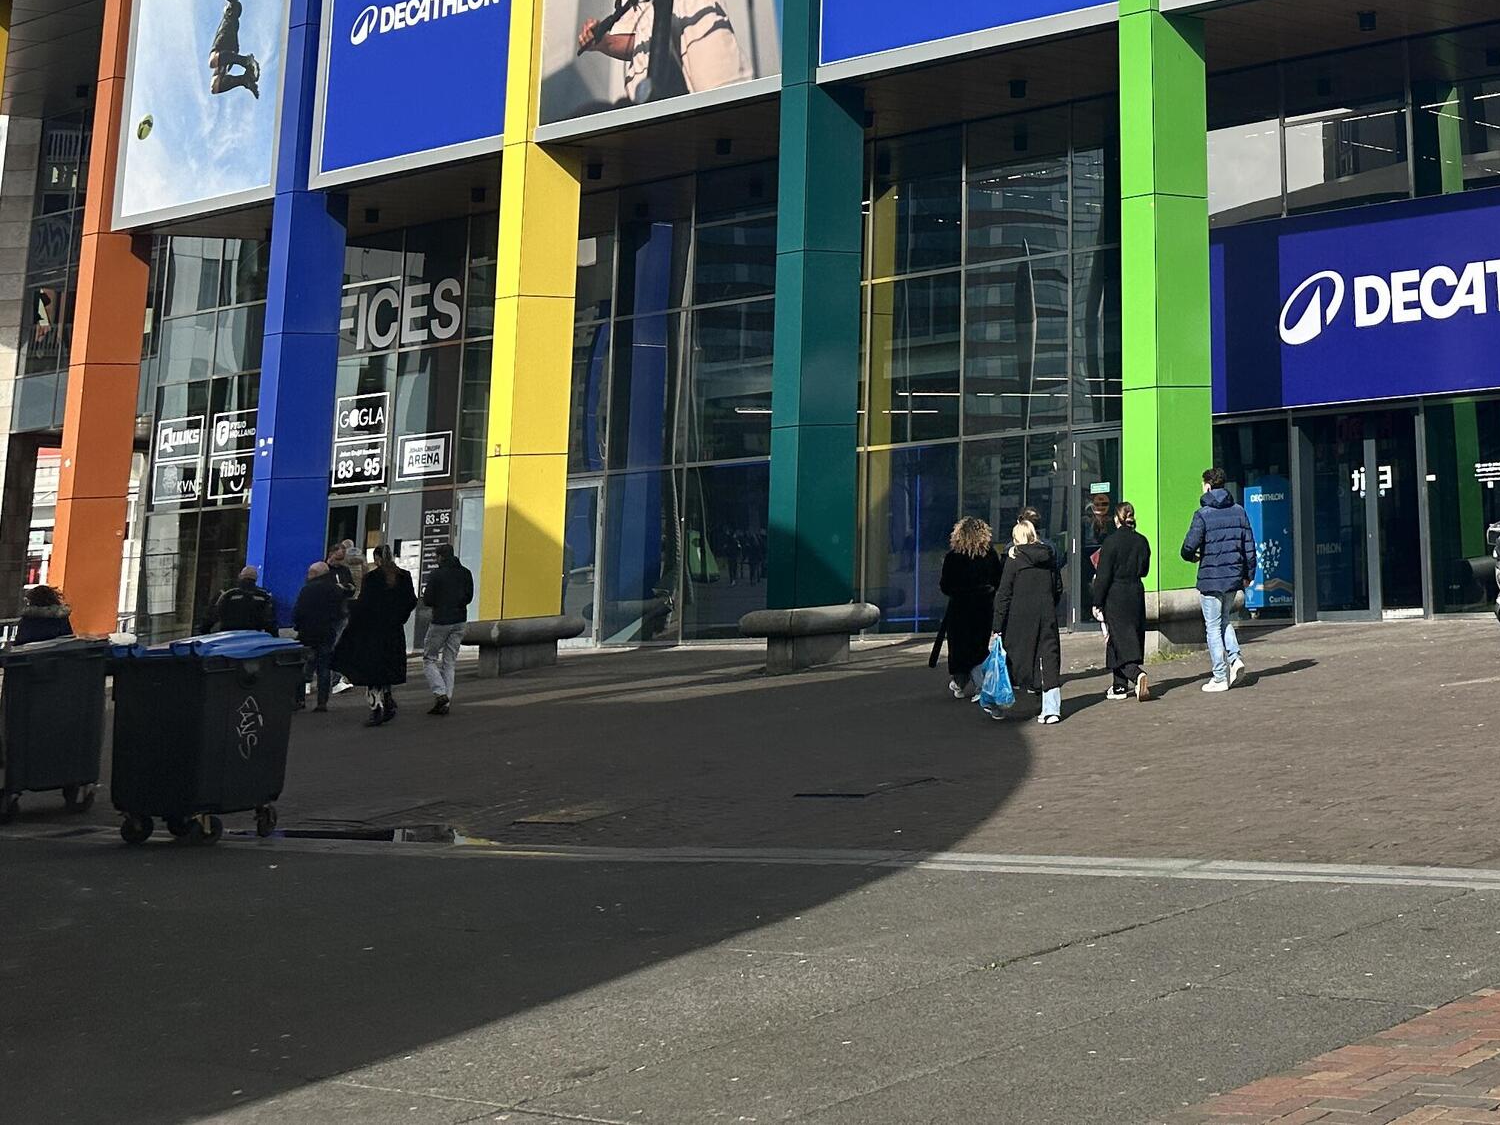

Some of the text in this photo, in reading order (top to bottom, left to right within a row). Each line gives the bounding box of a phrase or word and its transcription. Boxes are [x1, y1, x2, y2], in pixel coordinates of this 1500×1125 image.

[340, 277, 462, 351] FICES
[229, 427, 256, 439] HOLLAND
[408, 452, 440, 467] ARENA
